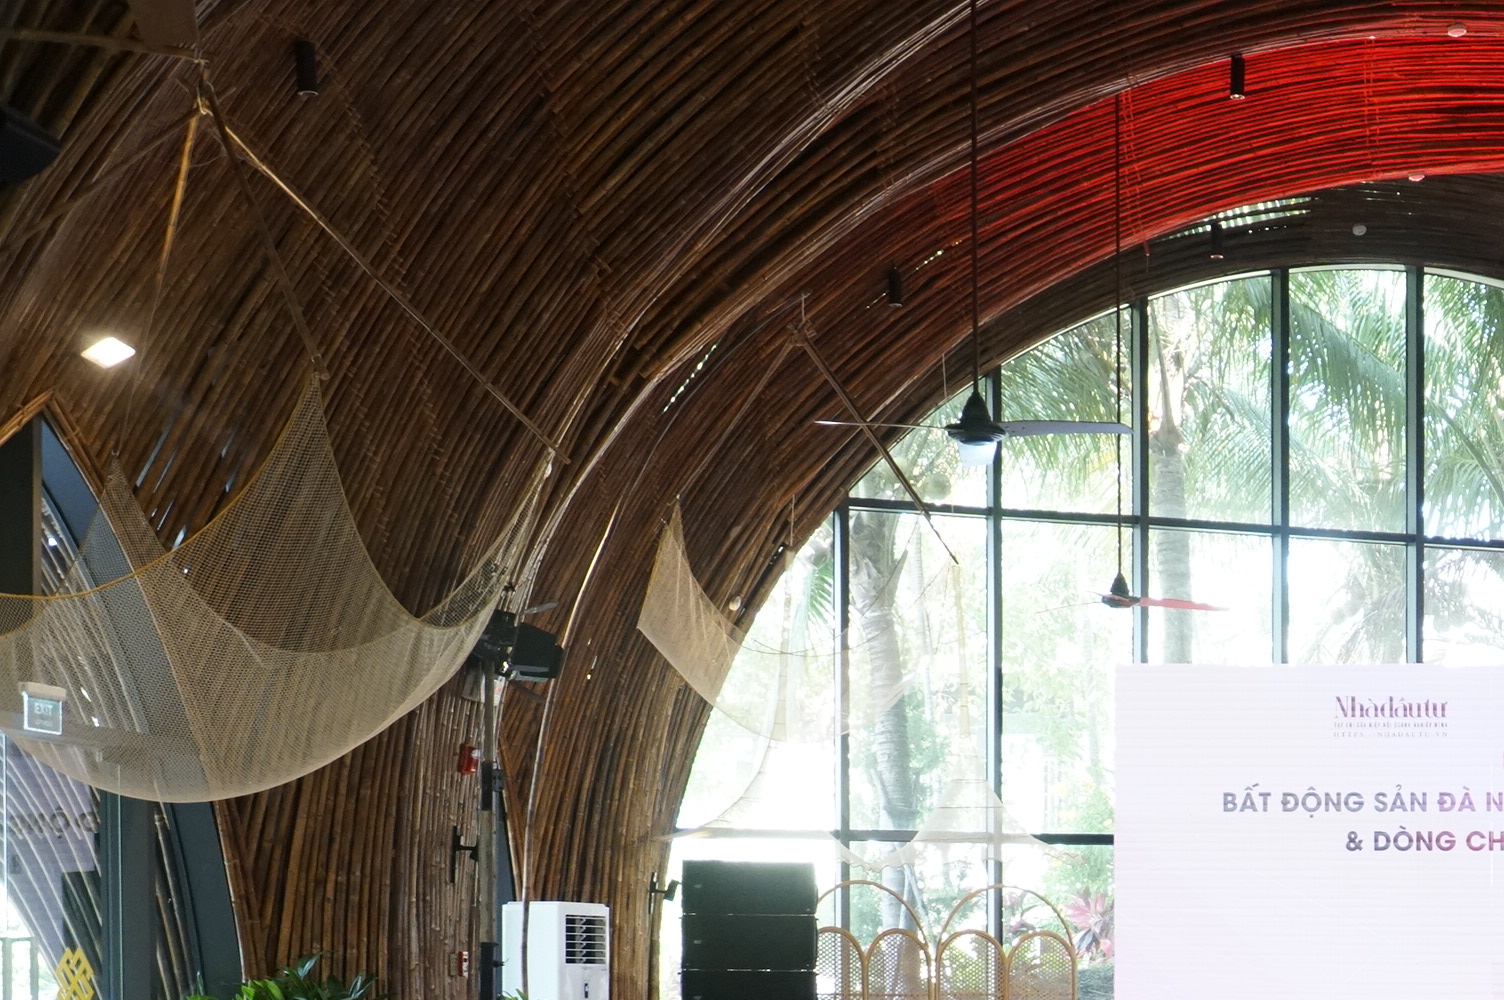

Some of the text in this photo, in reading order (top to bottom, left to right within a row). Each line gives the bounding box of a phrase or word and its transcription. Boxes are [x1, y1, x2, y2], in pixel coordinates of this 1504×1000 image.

[34, 702, 53, 716] EXIT
[1222, 783, 1272, 813] BẤT
[1281, 786, 1365, 818] ĐỘNG
[1373, 784, 1428, 812] SẢN
[1437, 785, 1476, 812] ĐÀ
[1345, 831, 1363, 851] &
[1373, 825, 1456, 851] DÒNG
